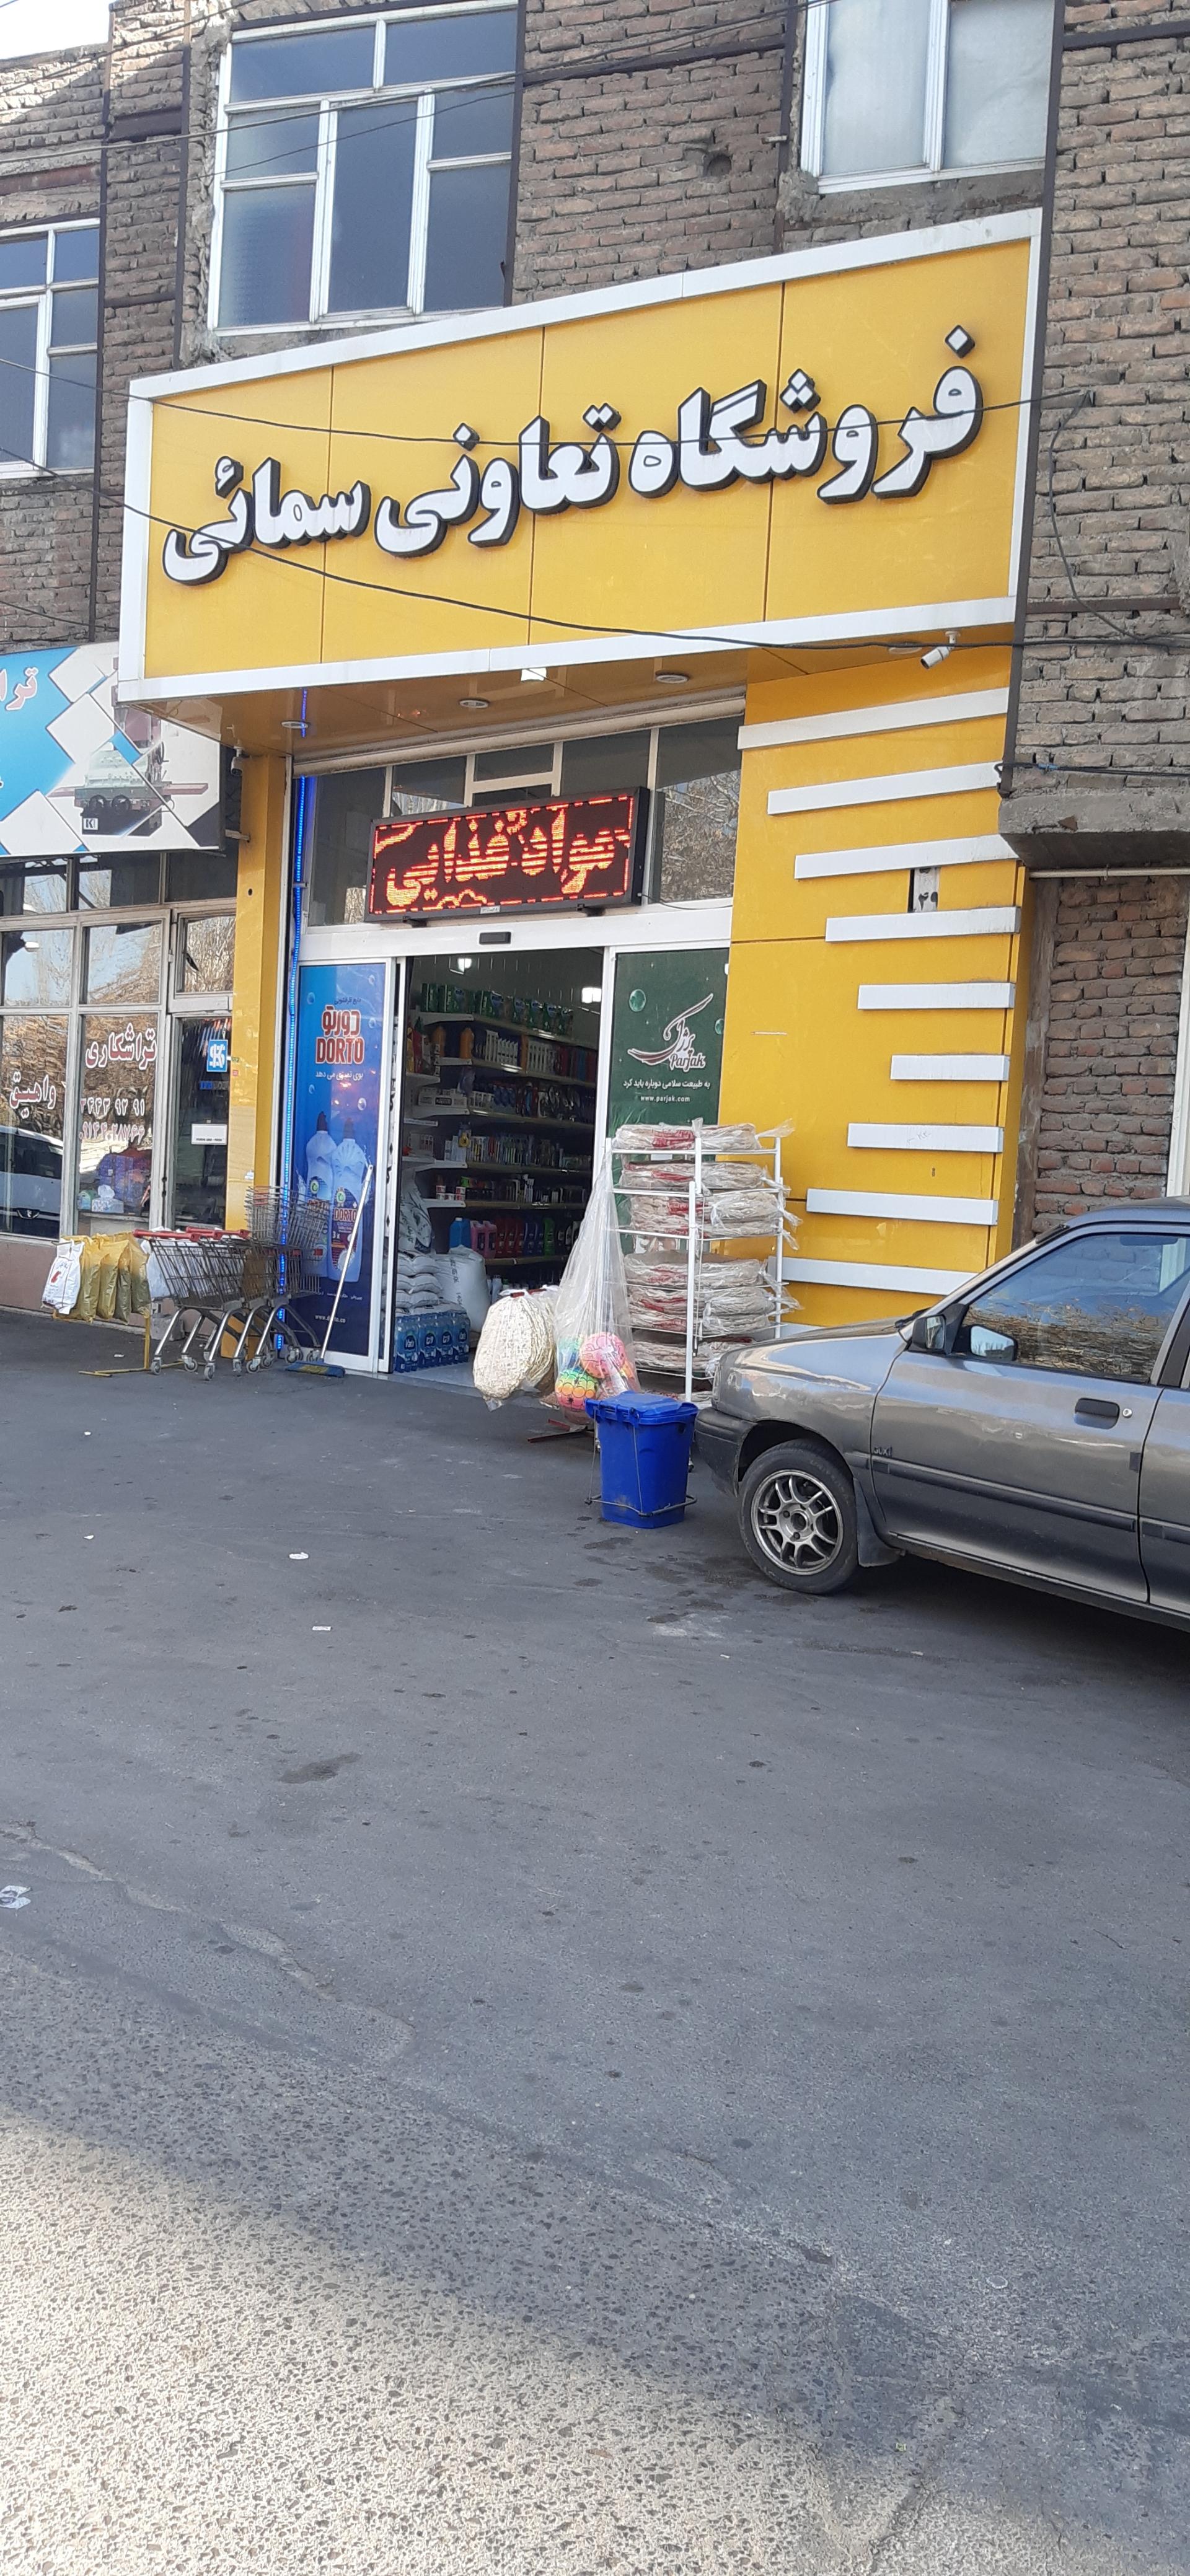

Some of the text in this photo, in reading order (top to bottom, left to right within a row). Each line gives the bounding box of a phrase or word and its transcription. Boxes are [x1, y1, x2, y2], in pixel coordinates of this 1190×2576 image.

[628, 325, 983, 504] فروشگاه
[374, 402, 621, 557] تعاونی
[322, 1004, 361, 1037] دورتو
[86, 1022, 157, 1070] تراشکاری
[315, 1037, 365, 1064] DORTO
[669, 1053, 705, 1072] Parjak
[623, 1078, 711, 1089] به طبیعت سلامی دوباره باید کرد
[640, 1095, 690, 1103] www.parjak.com
[334, 1208, 358, 1222] DORTO
